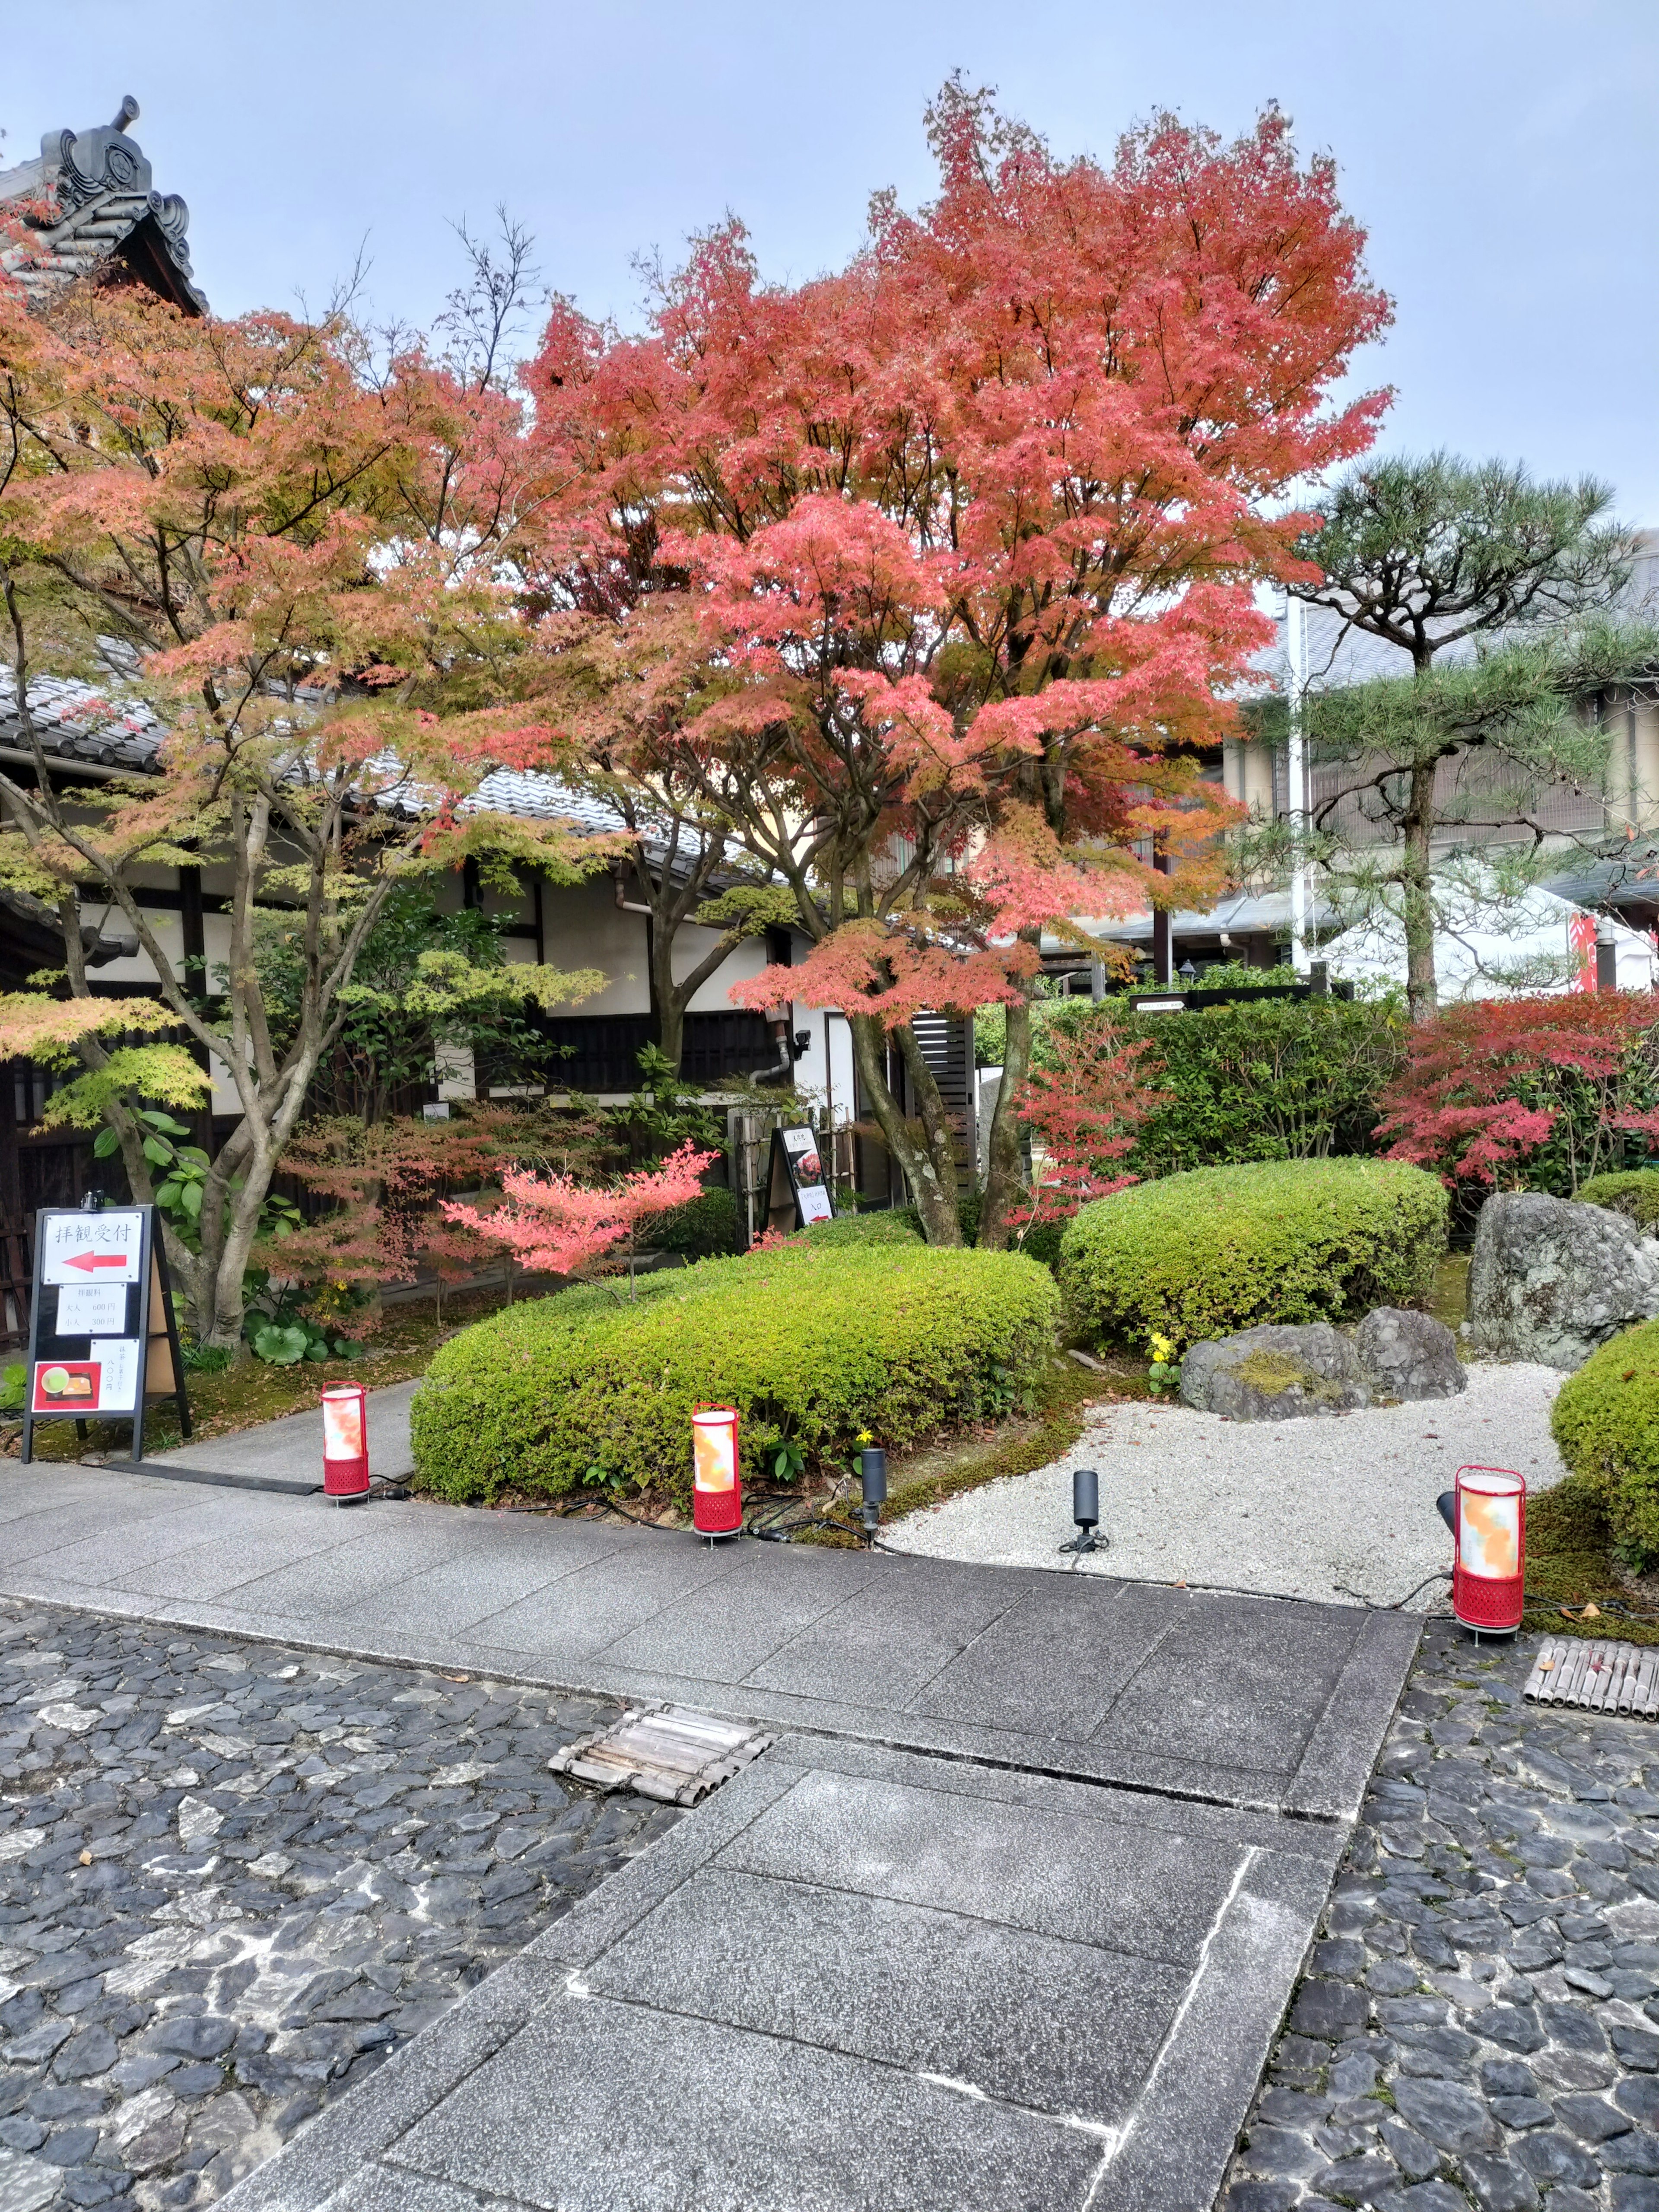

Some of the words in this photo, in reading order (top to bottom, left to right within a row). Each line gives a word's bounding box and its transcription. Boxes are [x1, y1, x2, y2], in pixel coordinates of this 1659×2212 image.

[810, 1203, 821, 1211] 入口
[55, 1223, 132, 1243] 拝観受付
[78, 1288, 101, 1297] 拝観料
[66, 1303, 81, 1312] 大人
[65, 1318, 80, 1327] 小人
